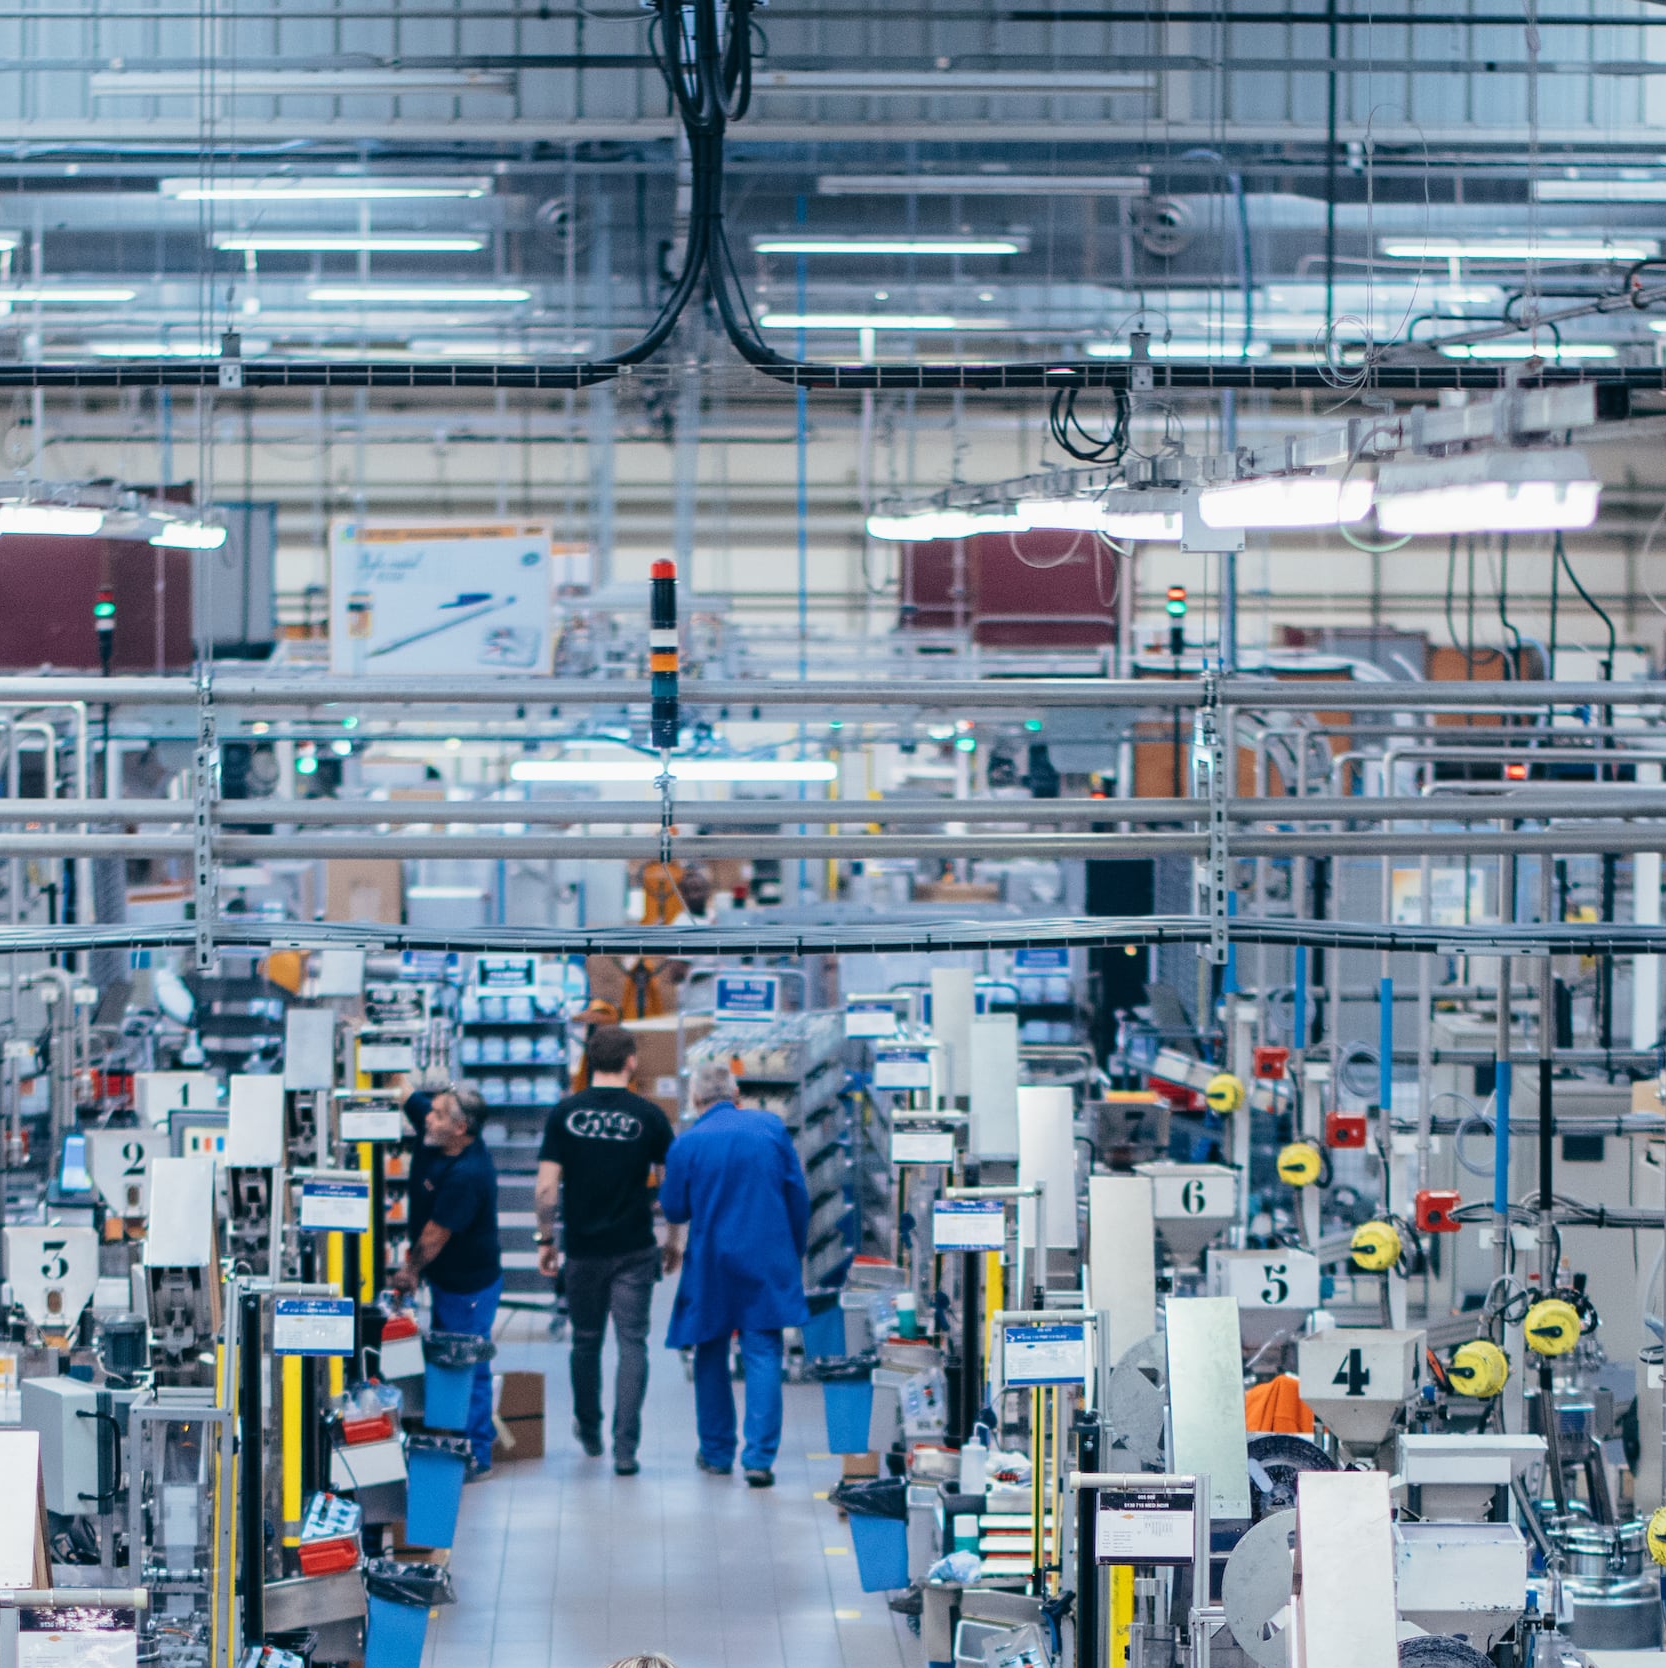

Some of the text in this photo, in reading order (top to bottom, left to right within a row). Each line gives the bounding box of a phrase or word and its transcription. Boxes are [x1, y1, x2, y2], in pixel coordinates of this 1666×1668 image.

[179, 1082, 189, 1106] 1
[122, 1142, 145, 1176] 2
[1182, 1179, 1206, 1215] 6
[41, 1240, 69, 1280] 3
[1261, 1264, 1289, 1305] 5
[1331, 1348, 1370, 1396] 4
